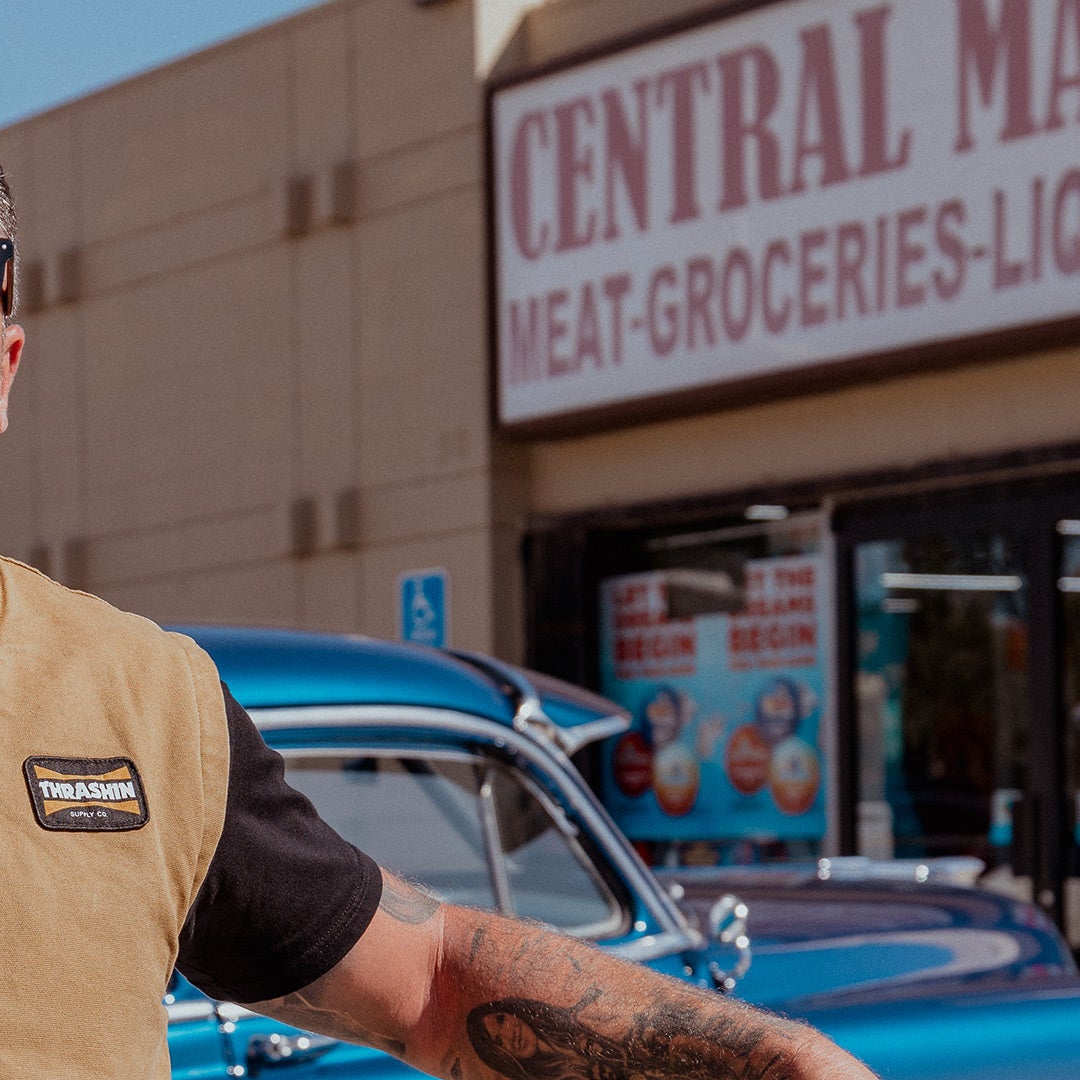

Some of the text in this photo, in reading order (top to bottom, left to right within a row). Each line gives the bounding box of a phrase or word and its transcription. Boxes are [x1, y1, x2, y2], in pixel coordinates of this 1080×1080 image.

[509, 5, 912, 263] CENTRAL
[729, 624, 816, 651] BEGIN
[38, 781, 136, 800] THRASHIN
